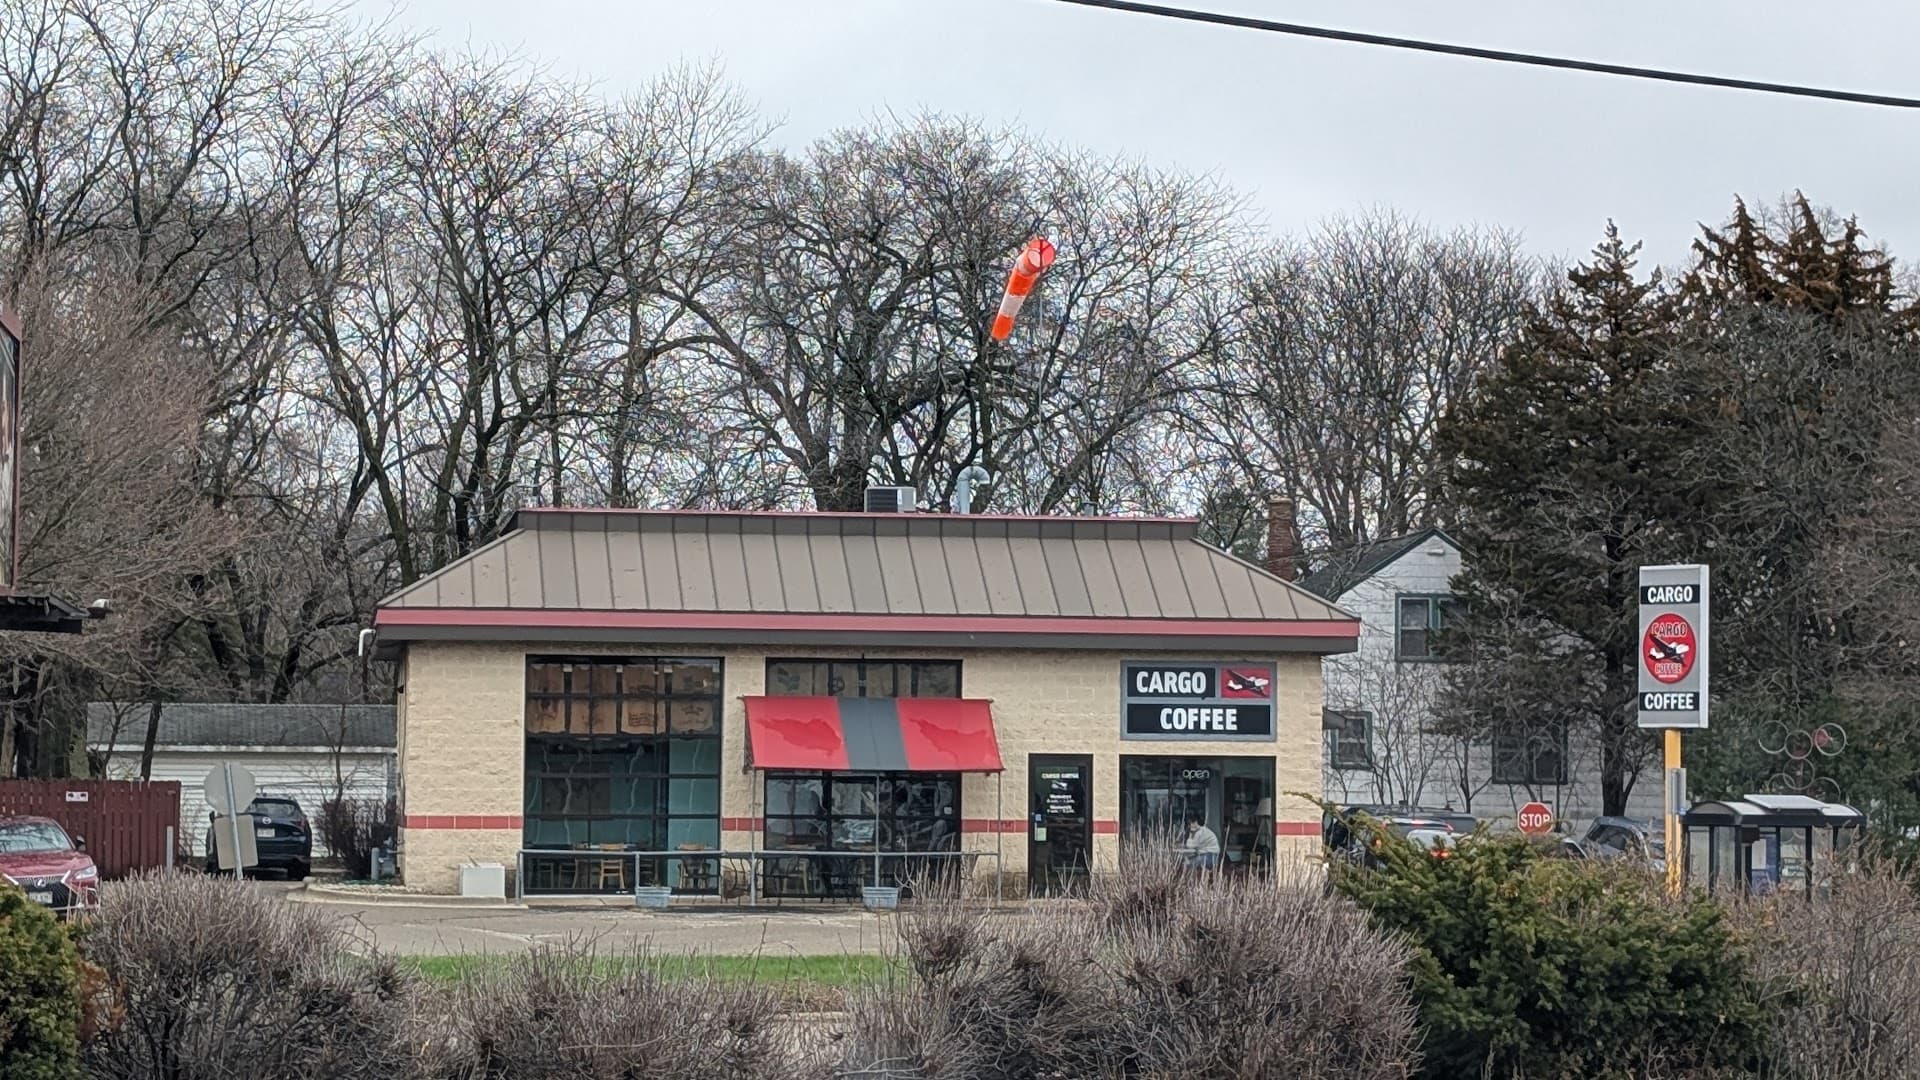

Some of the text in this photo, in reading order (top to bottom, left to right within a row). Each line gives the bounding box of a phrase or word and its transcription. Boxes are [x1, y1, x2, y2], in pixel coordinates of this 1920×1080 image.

[1648, 585, 1693, 603] CARGO
[1651, 621, 1688, 637] CARGO
[1136, 671, 1207, 694] CARGO
[1644, 693, 1694, 710] COFFEE
[1160, 707, 1238, 731] COFFEE
[1520, 813, 1550, 827] STOP
